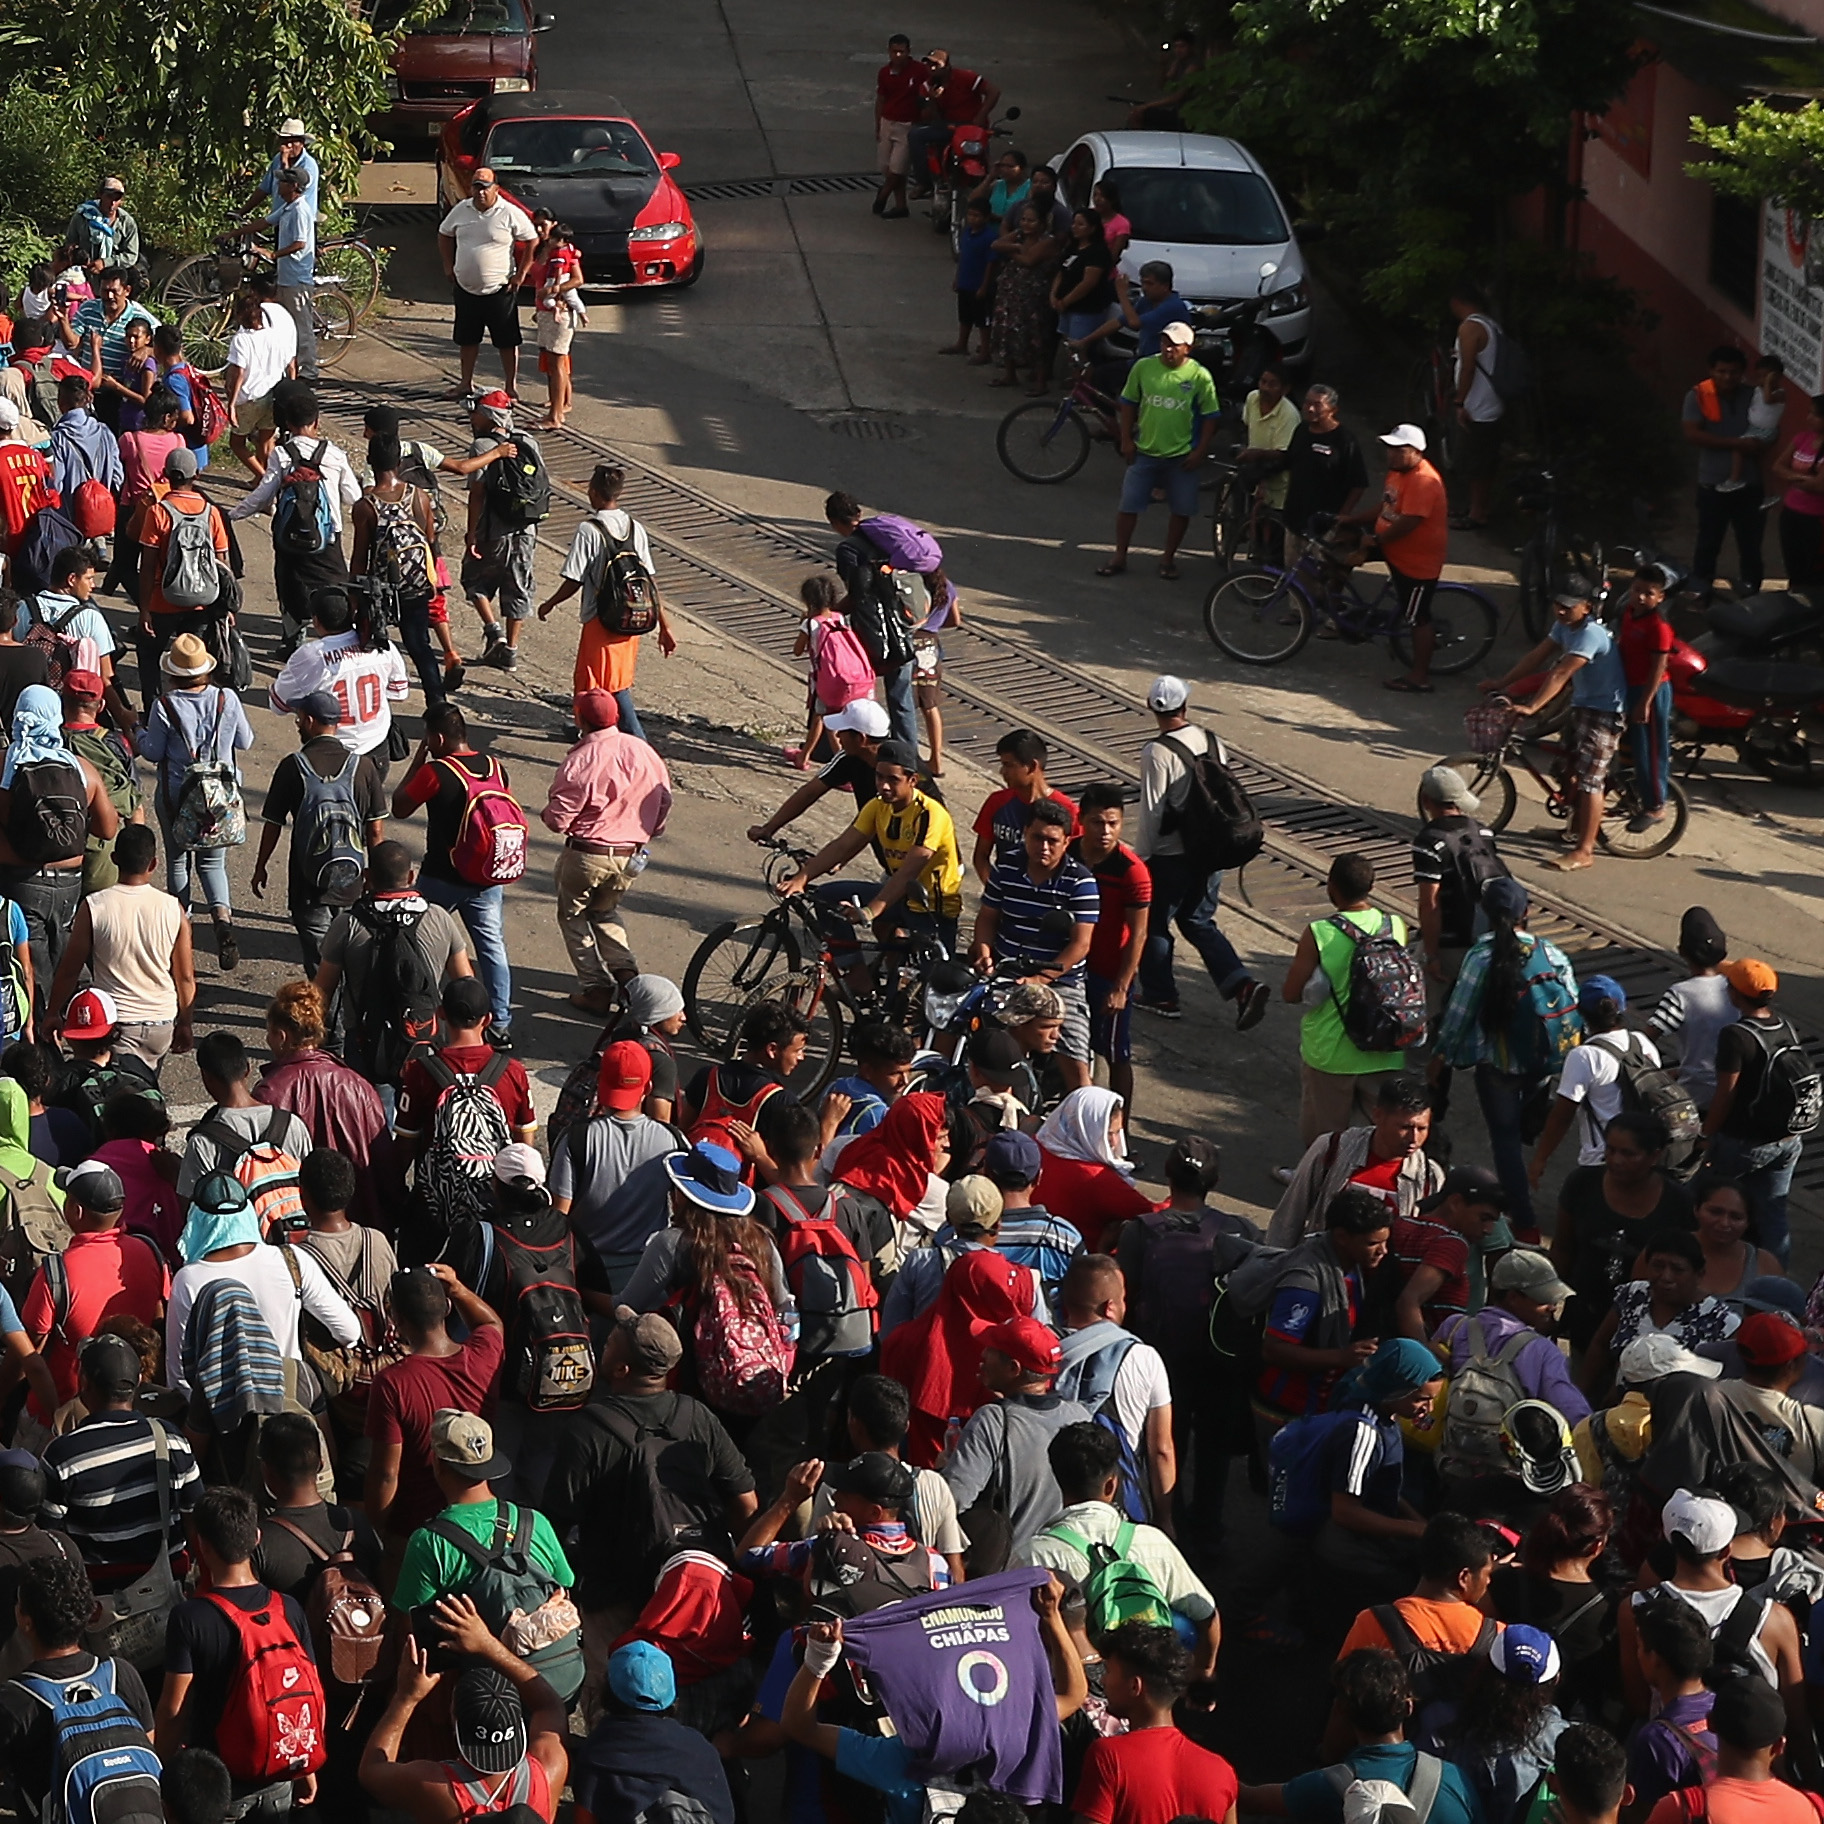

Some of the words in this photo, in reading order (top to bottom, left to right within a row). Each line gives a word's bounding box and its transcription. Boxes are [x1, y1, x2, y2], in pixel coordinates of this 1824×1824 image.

[1145, 395, 1186, 410] XBOX
[7, 453, 37, 470] RAUL
[16, 474, 36, 519] 7
[332, 673, 381, 727] 10
[993, 823, 1025, 843] MERIC
[550, 1364, 585, 1381] NIKE
[960, 1622, 973, 1630] DE
[929, 1627, 1011, 1649] CHIAPAS
[103, 1755, 132, 1767] Reebok
